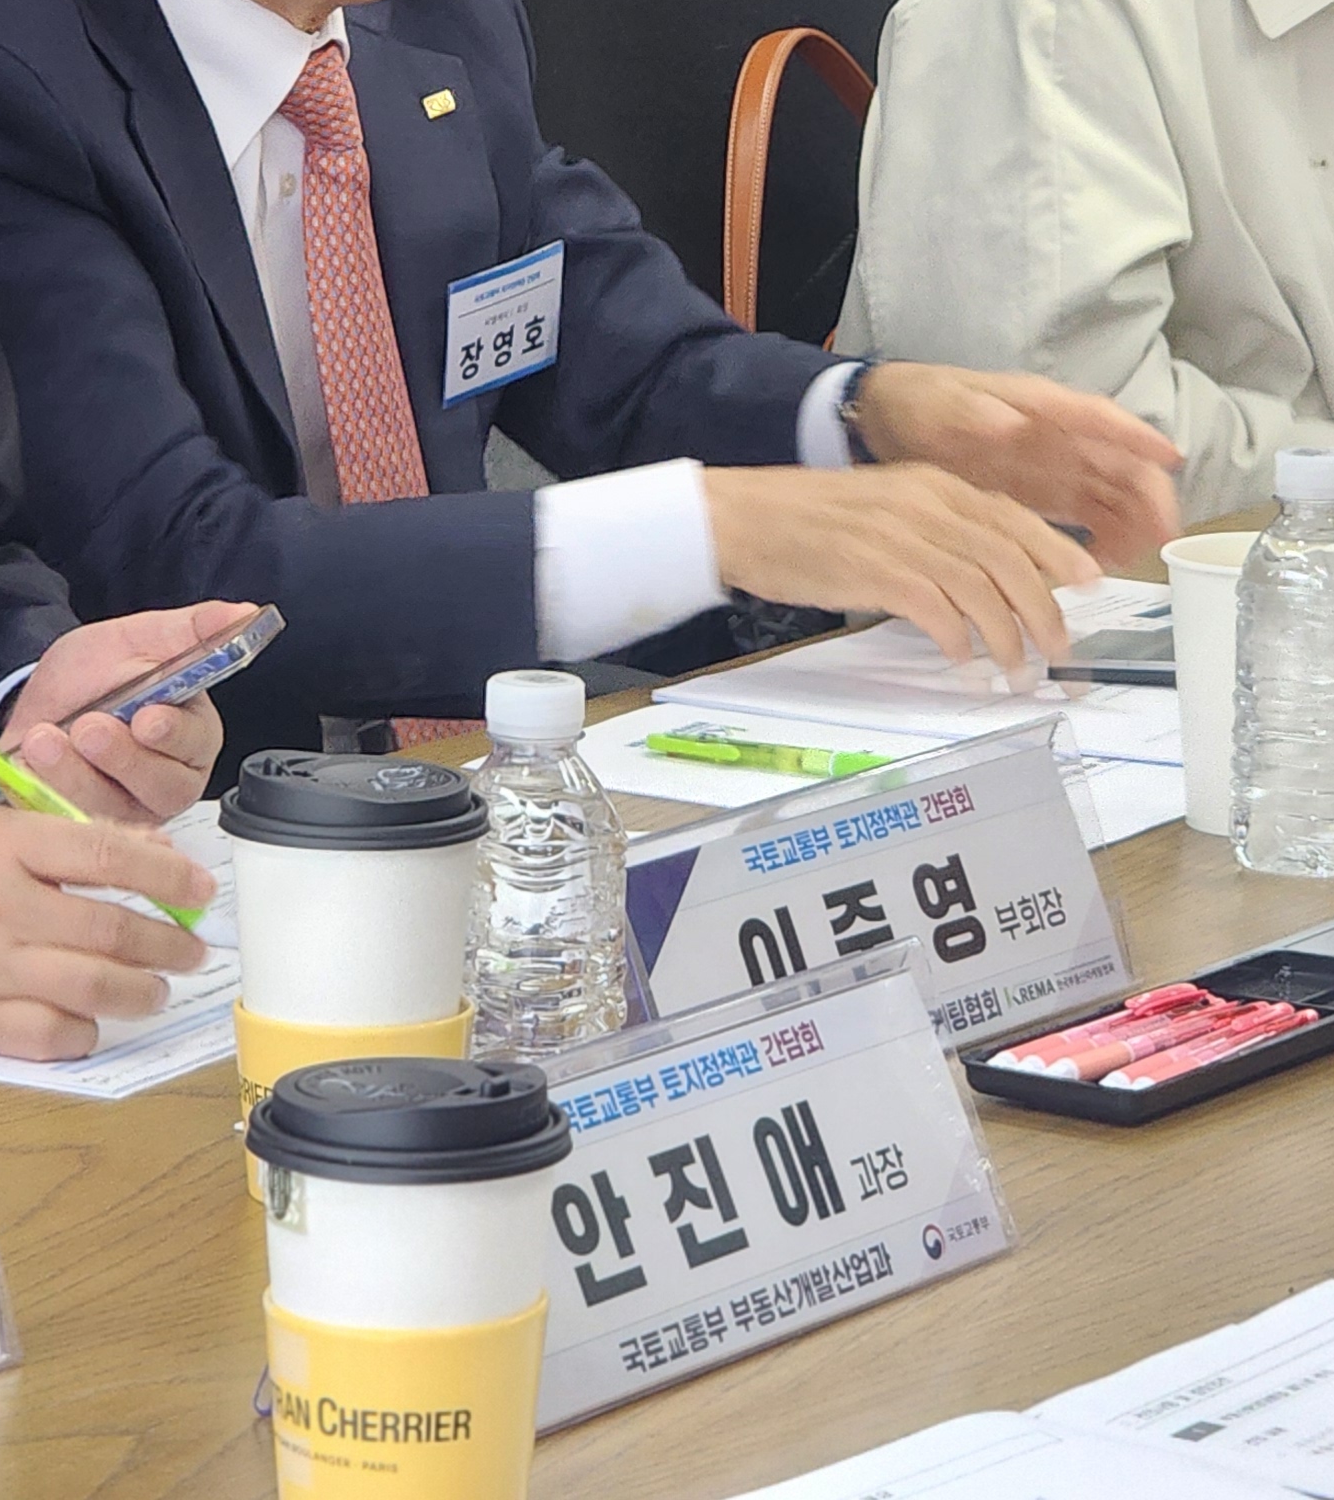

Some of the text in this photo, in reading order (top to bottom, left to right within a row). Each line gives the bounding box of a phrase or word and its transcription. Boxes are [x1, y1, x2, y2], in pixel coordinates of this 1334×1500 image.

[742, 784, 976, 874] 국토교통부 토지정책관 간담회
[995, 886, 1068, 942] 부회장
[559, 1018, 825, 1133] 국토교통부 토지정책관 간담회
[850, 1143, 910, 1201] 과장
[619, 1239, 894, 1376] 국토교통부 부동산개발산업과
